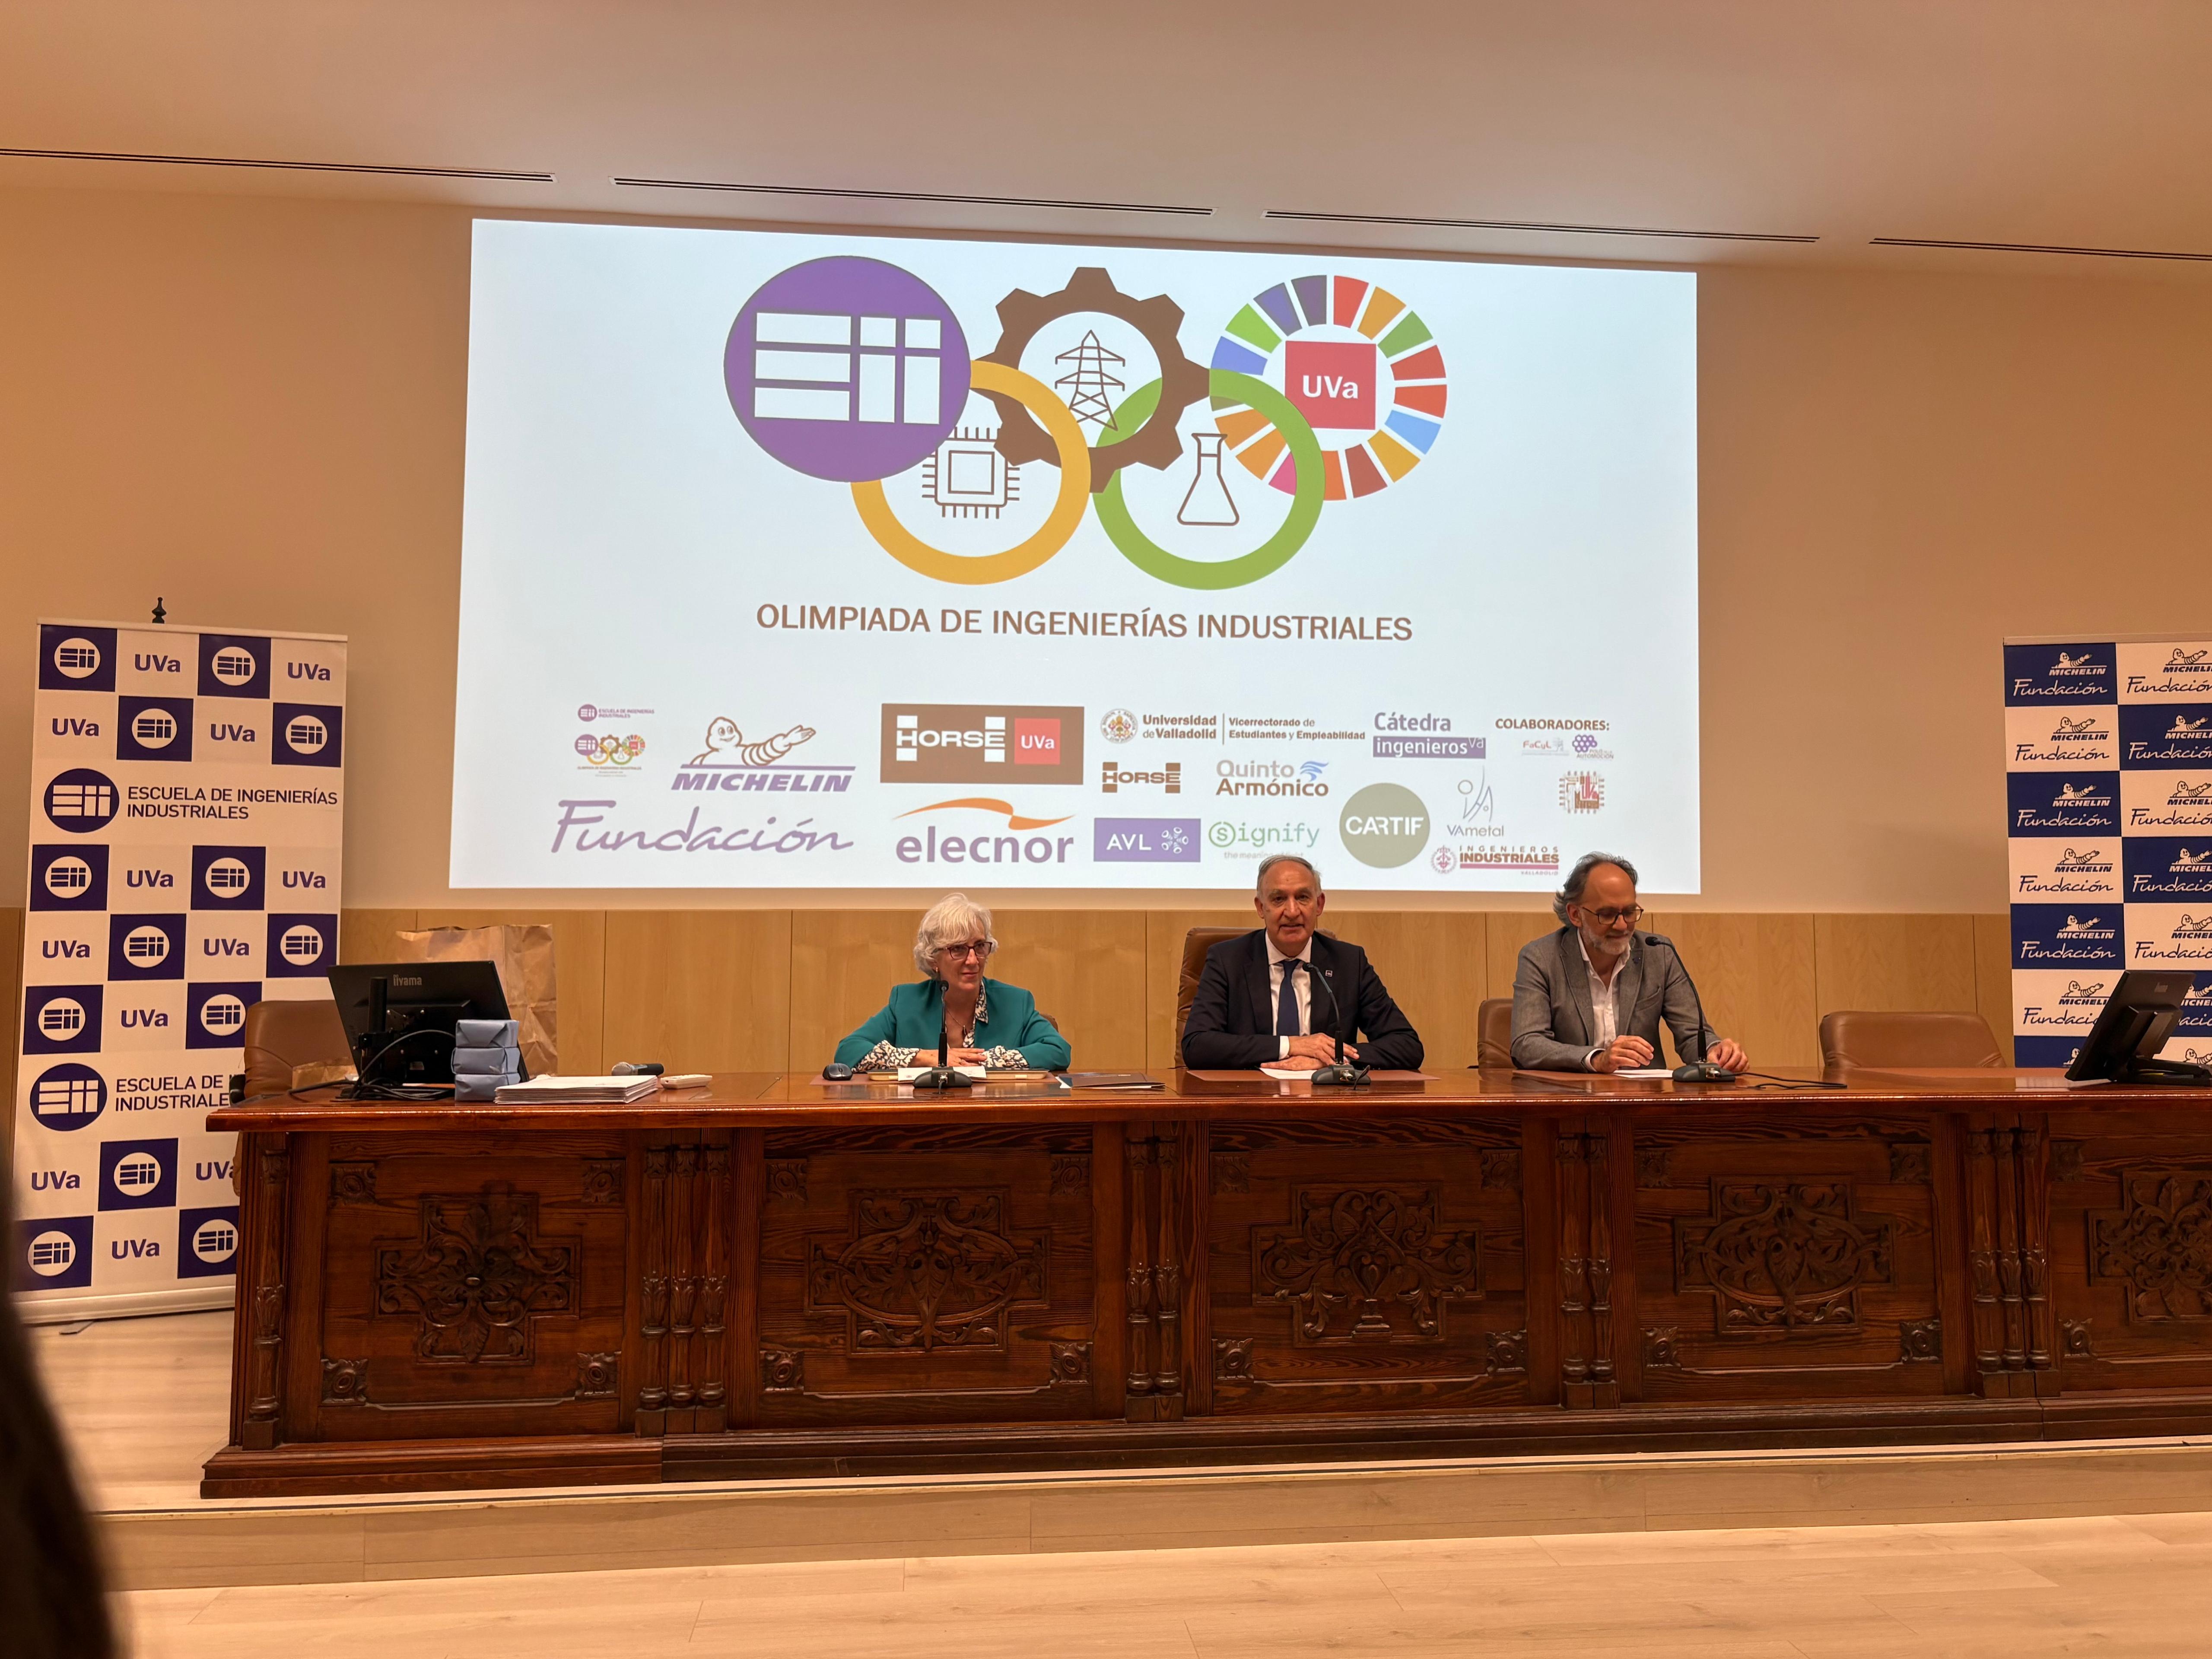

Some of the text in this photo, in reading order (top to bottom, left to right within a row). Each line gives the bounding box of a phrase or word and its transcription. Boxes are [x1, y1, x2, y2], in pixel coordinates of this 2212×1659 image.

[1302, 375, 1359, 400] UVa
[757, 604, 1413, 641] OLIMPIADA DE INGENIERÍAS INDUSTRIALES
[135, 654, 181, 673] UVa
[287, 662, 331, 681] UVa
[2049, 667, 2107, 676] MICHELIN
[2013, 678, 2107, 696] Fundación
[52, 718, 99, 737] UVa
[1143, 714, 1217, 726] Universidad
[1229, 718, 1315, 727] Vicerrectorado de
[1374, 712, 1451, 731] Cátedra
[1495, 718, 1610, 731] COLABORADORES:
[210, 723, 255, 742] UVa
[1021, 735, 1055, 749] UVa
[1155, 728, 1217, 739] Valladolid
[1229, 730, 1366, 741] Estudiantes y Empleabilidad
[2050, 733, 2109, 741] MICHELIN
[1522, 740, 1552, 750] FaCyL
[2015, 744, 2110, 761] Fundación
[1216, 760, 1295, 779] Quinto
[671, 773, 852, 792] MICHELIN
[1215, 778, 1329, 797] Armónico
[128, 786, 338, 805] ESCUELA DE INGENIERÍAS
[127, 804, 249, 820] INDUSTRIALES
[2017, 809, 2112, 827] Fundación
[2130, 808, 2212, 826] Fundació
[550, 800, 854, 853] Fundación
[1208, 821, 1320, 848] signify
[1345, 816, 1424, 836] CARTIF
[1446, 824, 1504, 837] VAmetal
[896, 826, 1074, 863] elecnor
[1106, 833, 1152, 851] AVL
[1459, 852, 1560, 864] INDUSTRIALES
[126, 869, 174, 888] UVa
[282, 871, 326, 889] UVa
[2019, 875, 2114, 893] Fundación
[2133, 874, 2212, 893] Fundació
[42, 940, 90, 959] UVa
[203, 938, 249, 957] UVa
[2021, 941, 2116, 959] Fundación
[393, 974, 422, 986] iiyama
[121, 1009, 168, 1028] UVa
[2023, 1007, 2098, 1024] Fundaci
[116, 1074, 224, 1093] ESCUELA DE
[115, 1093, 229, 1112] INDUSTRIALE
[31, 1170, 80, 1191] UVa
[111, 1239, 160, 1259] UVa
